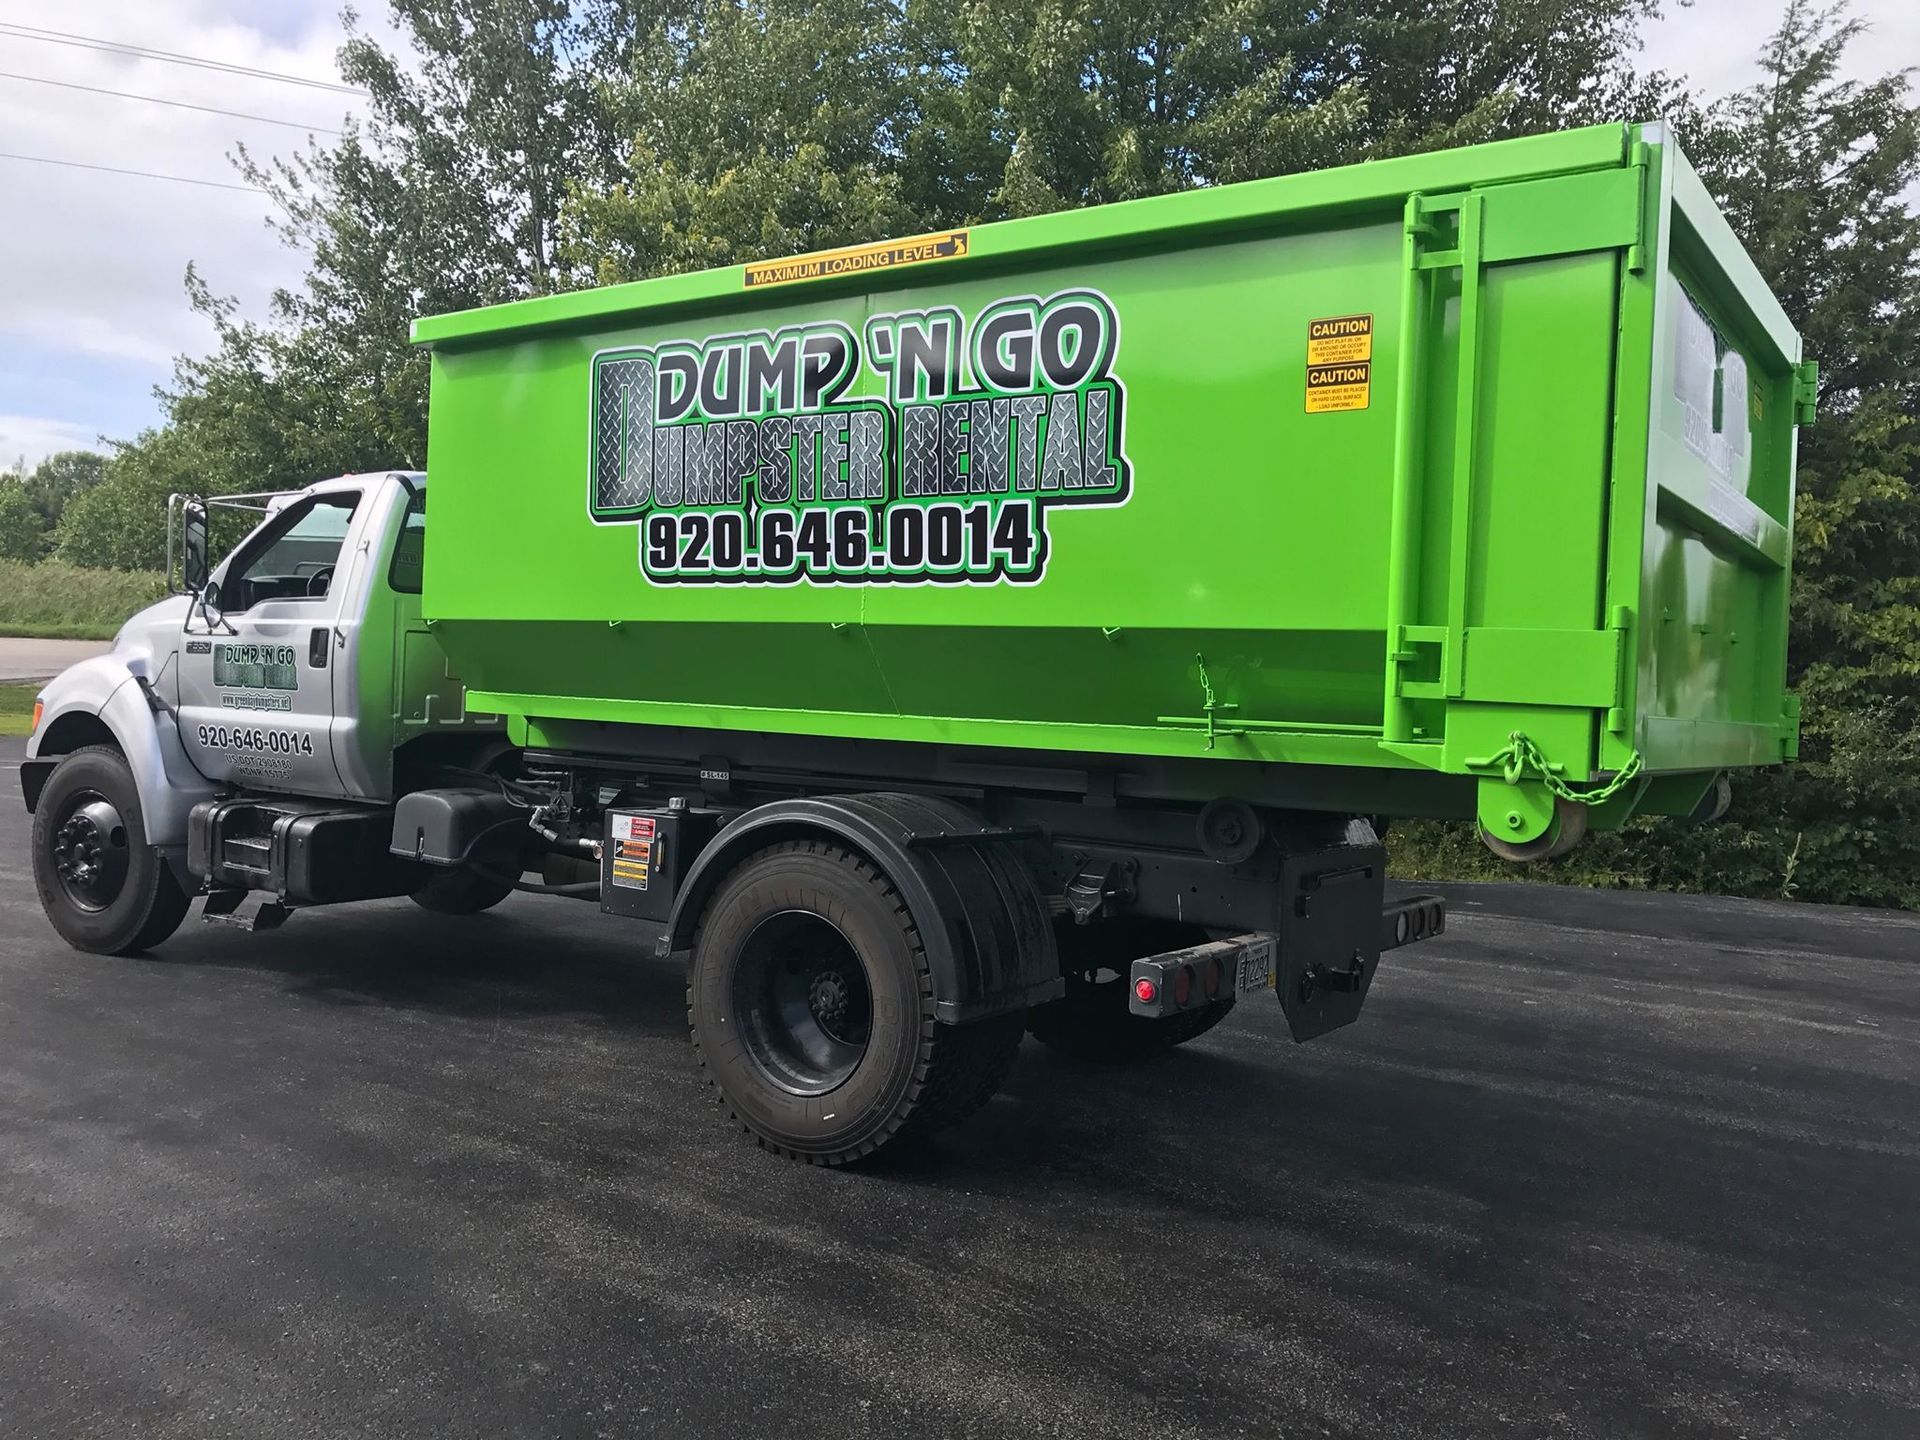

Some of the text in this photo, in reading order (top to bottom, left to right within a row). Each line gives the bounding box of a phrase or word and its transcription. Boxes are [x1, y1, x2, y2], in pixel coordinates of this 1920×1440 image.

[753, 245, 943, 285] MAXIMUM LOADING LEVEL
[1312, 320, 1368, 336] CAUTION
[657, 335, 848, 421] DUMP
[983, 305, 1106, 390] GO
[1310, 368, 1366, 384] CAUTION
[595, 358, 1117, 510] DUMPSTER RENTAL
[647, 503, 1034, 570] 920.646.0014
[226, 647, 257, 663] DUMP
[277, 648, 294, 665] GO
[199, 725, 313, 755] 920-646-0014
[239, 755, 255, 766] DOT
